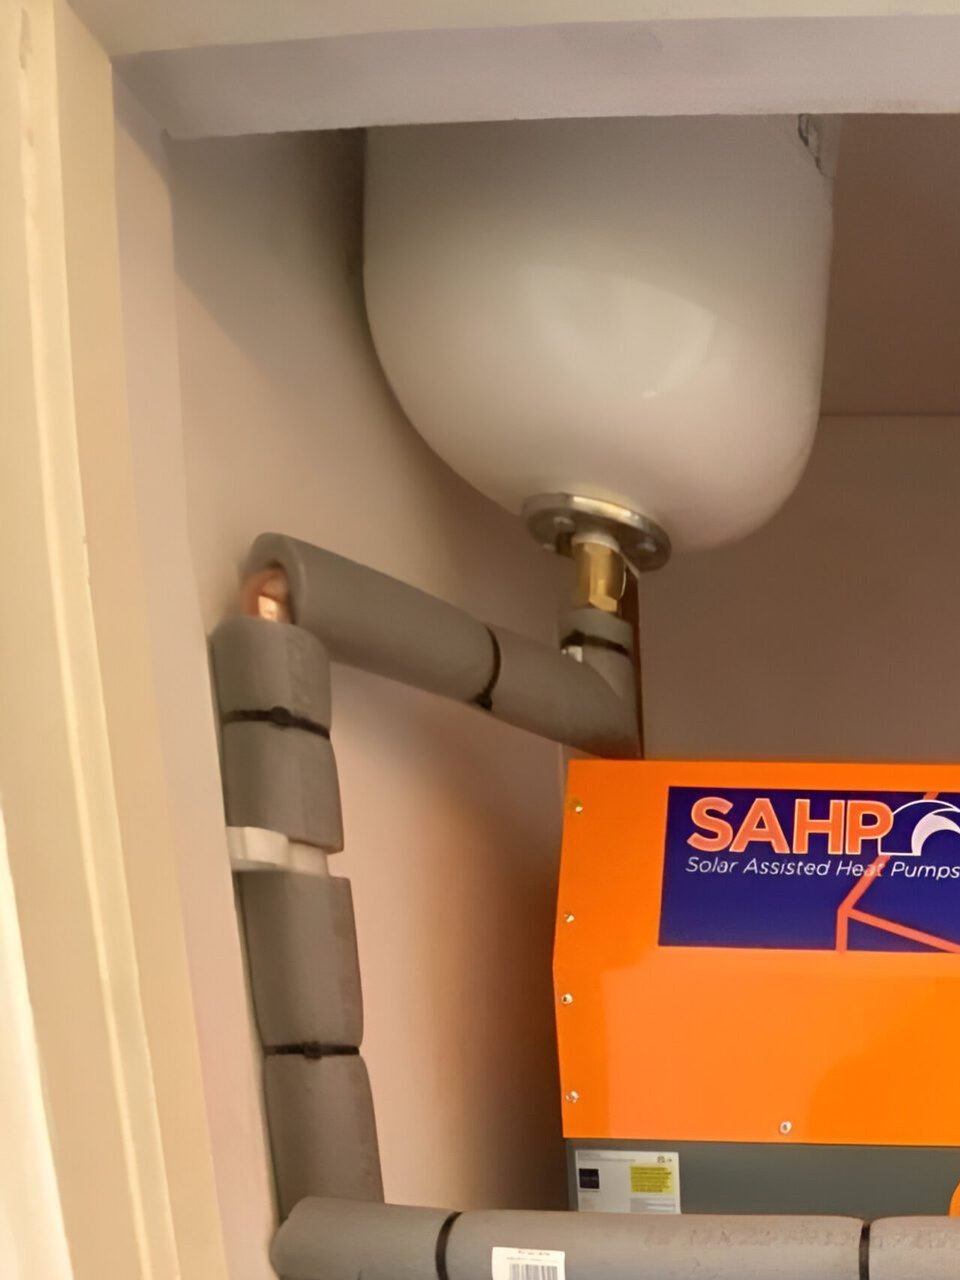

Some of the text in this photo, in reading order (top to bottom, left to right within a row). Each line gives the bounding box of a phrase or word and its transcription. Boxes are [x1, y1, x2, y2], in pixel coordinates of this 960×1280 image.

[686, 797, 894, 855] SAHP
[685, 856, 960, 880] Solar Assisted Heat Pumps
